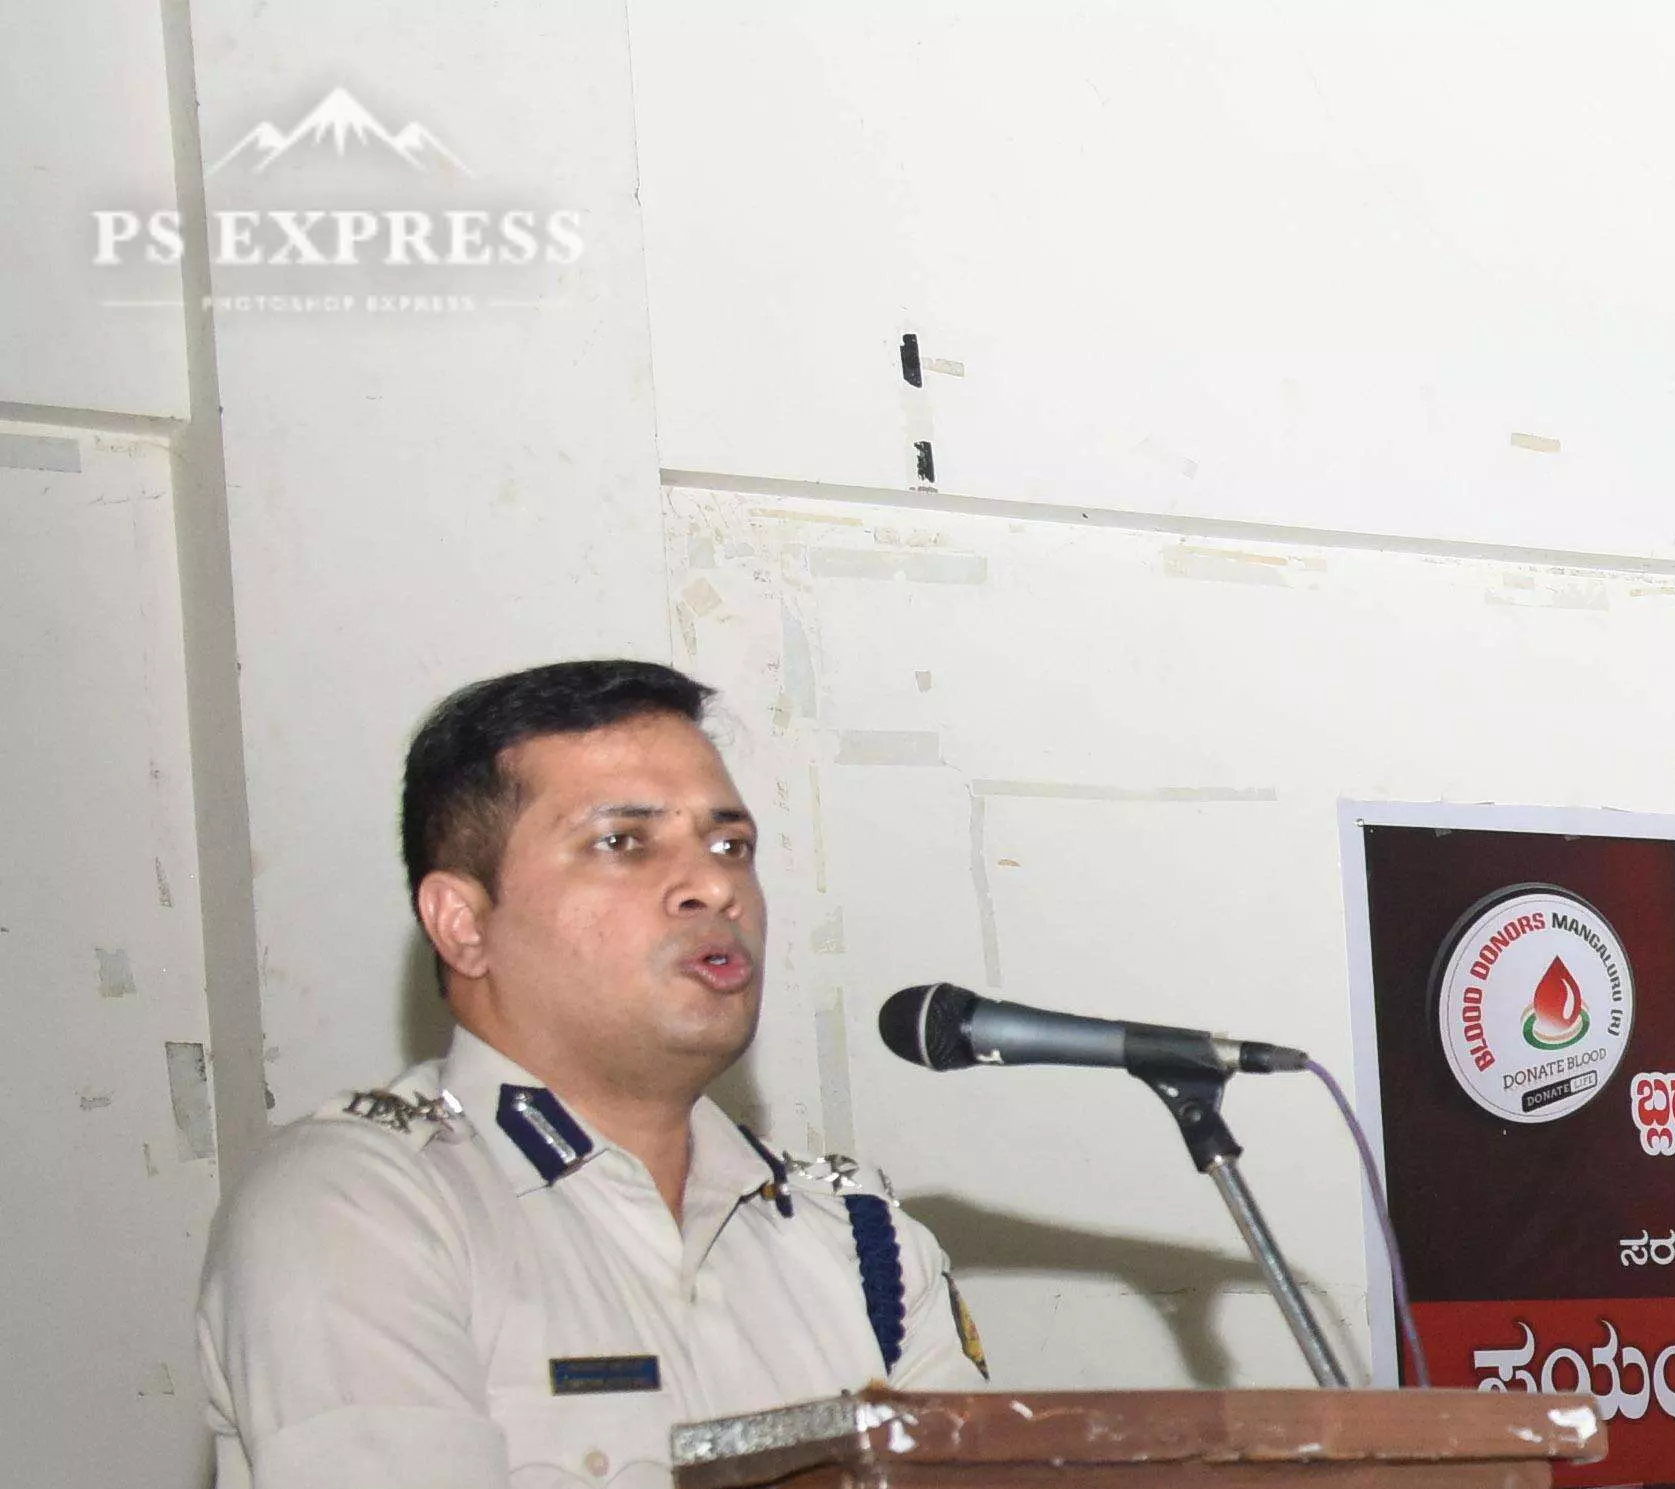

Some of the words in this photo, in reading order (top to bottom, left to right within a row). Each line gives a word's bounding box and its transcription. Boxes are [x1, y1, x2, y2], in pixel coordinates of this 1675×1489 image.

[1470, 912, 1546, 981] DONORS
[1551, 912, 1623, 1002] MANGALURU
[1462, 987, 1496, 1072] BLOOD
[1503, 1059, 1565, 1090] DONATE
[1567, 1048, 1607, 1071] BLOOD
[1526, 1081, 1570, 1107] DONATE
